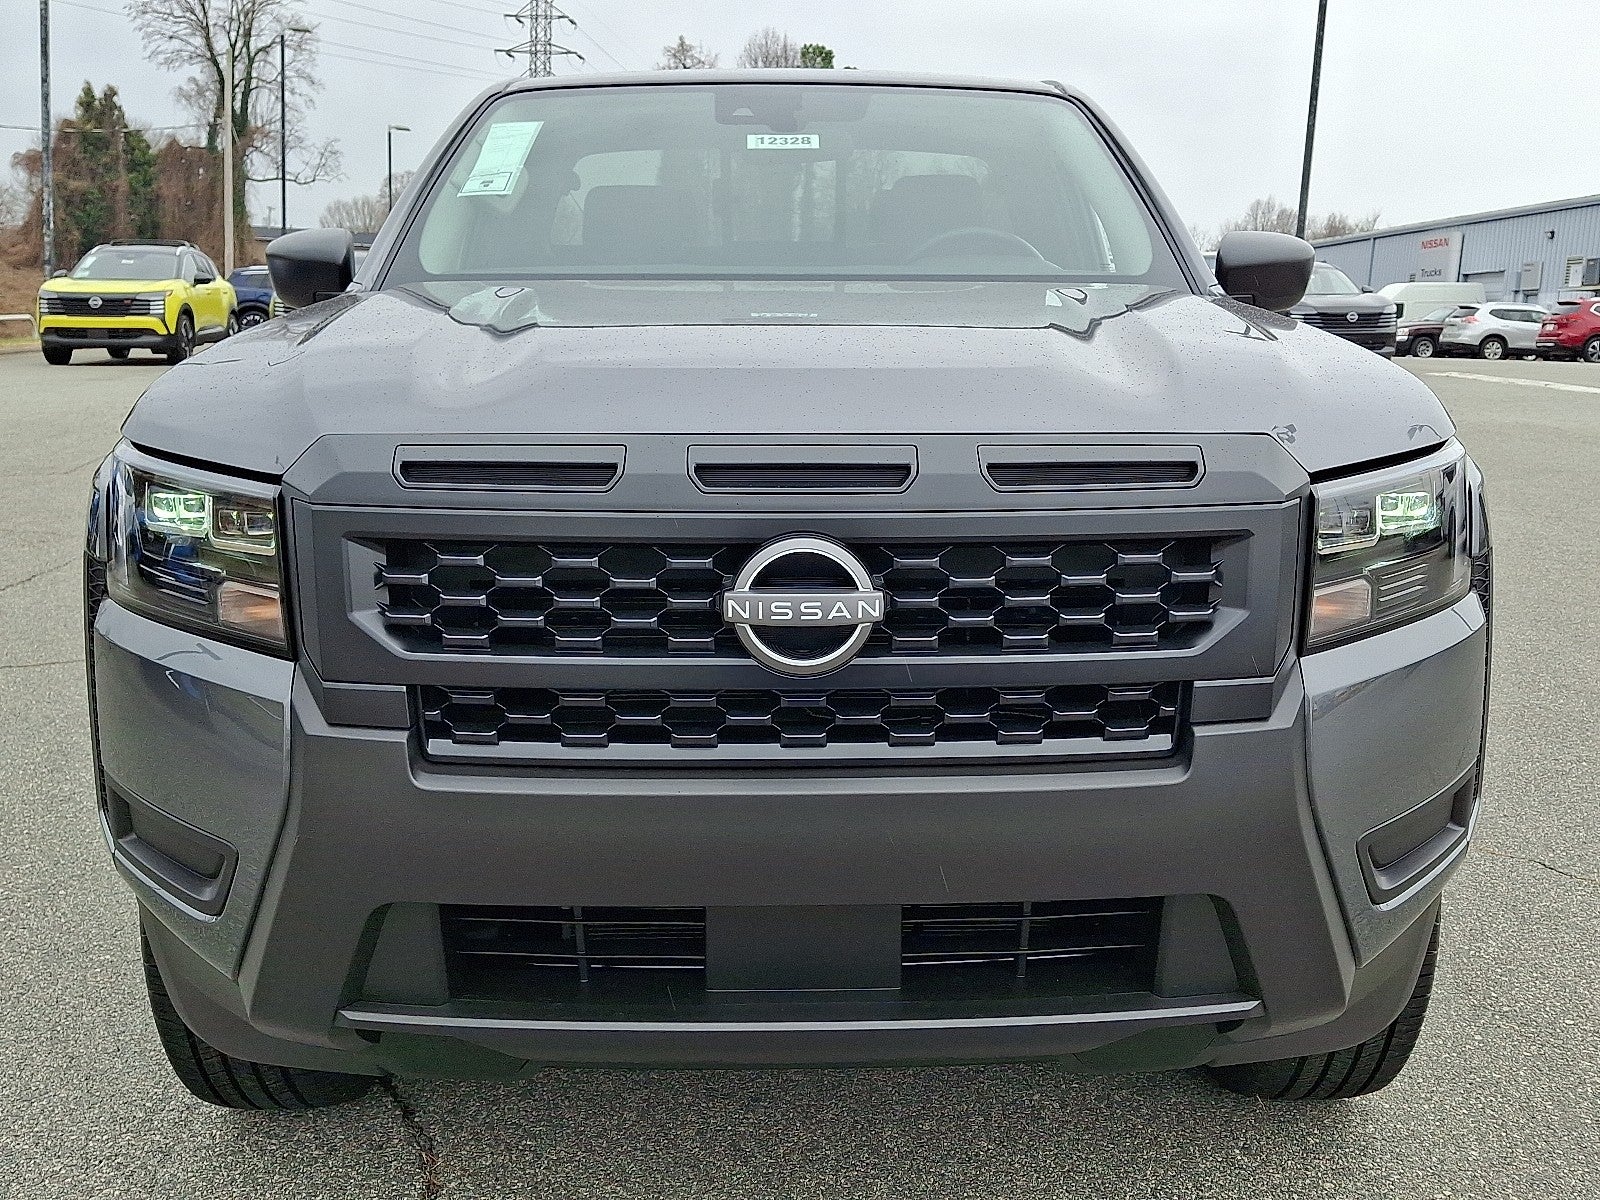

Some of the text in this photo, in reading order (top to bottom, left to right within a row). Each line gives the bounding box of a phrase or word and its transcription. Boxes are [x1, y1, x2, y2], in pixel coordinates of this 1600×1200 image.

[756, 136, 811, 145] 12328
[1421, 238, 1449, 249] NISSAN
[1421, 268, 1442, 277] Trucks
[727, 599, 880, 620] NISSAN
